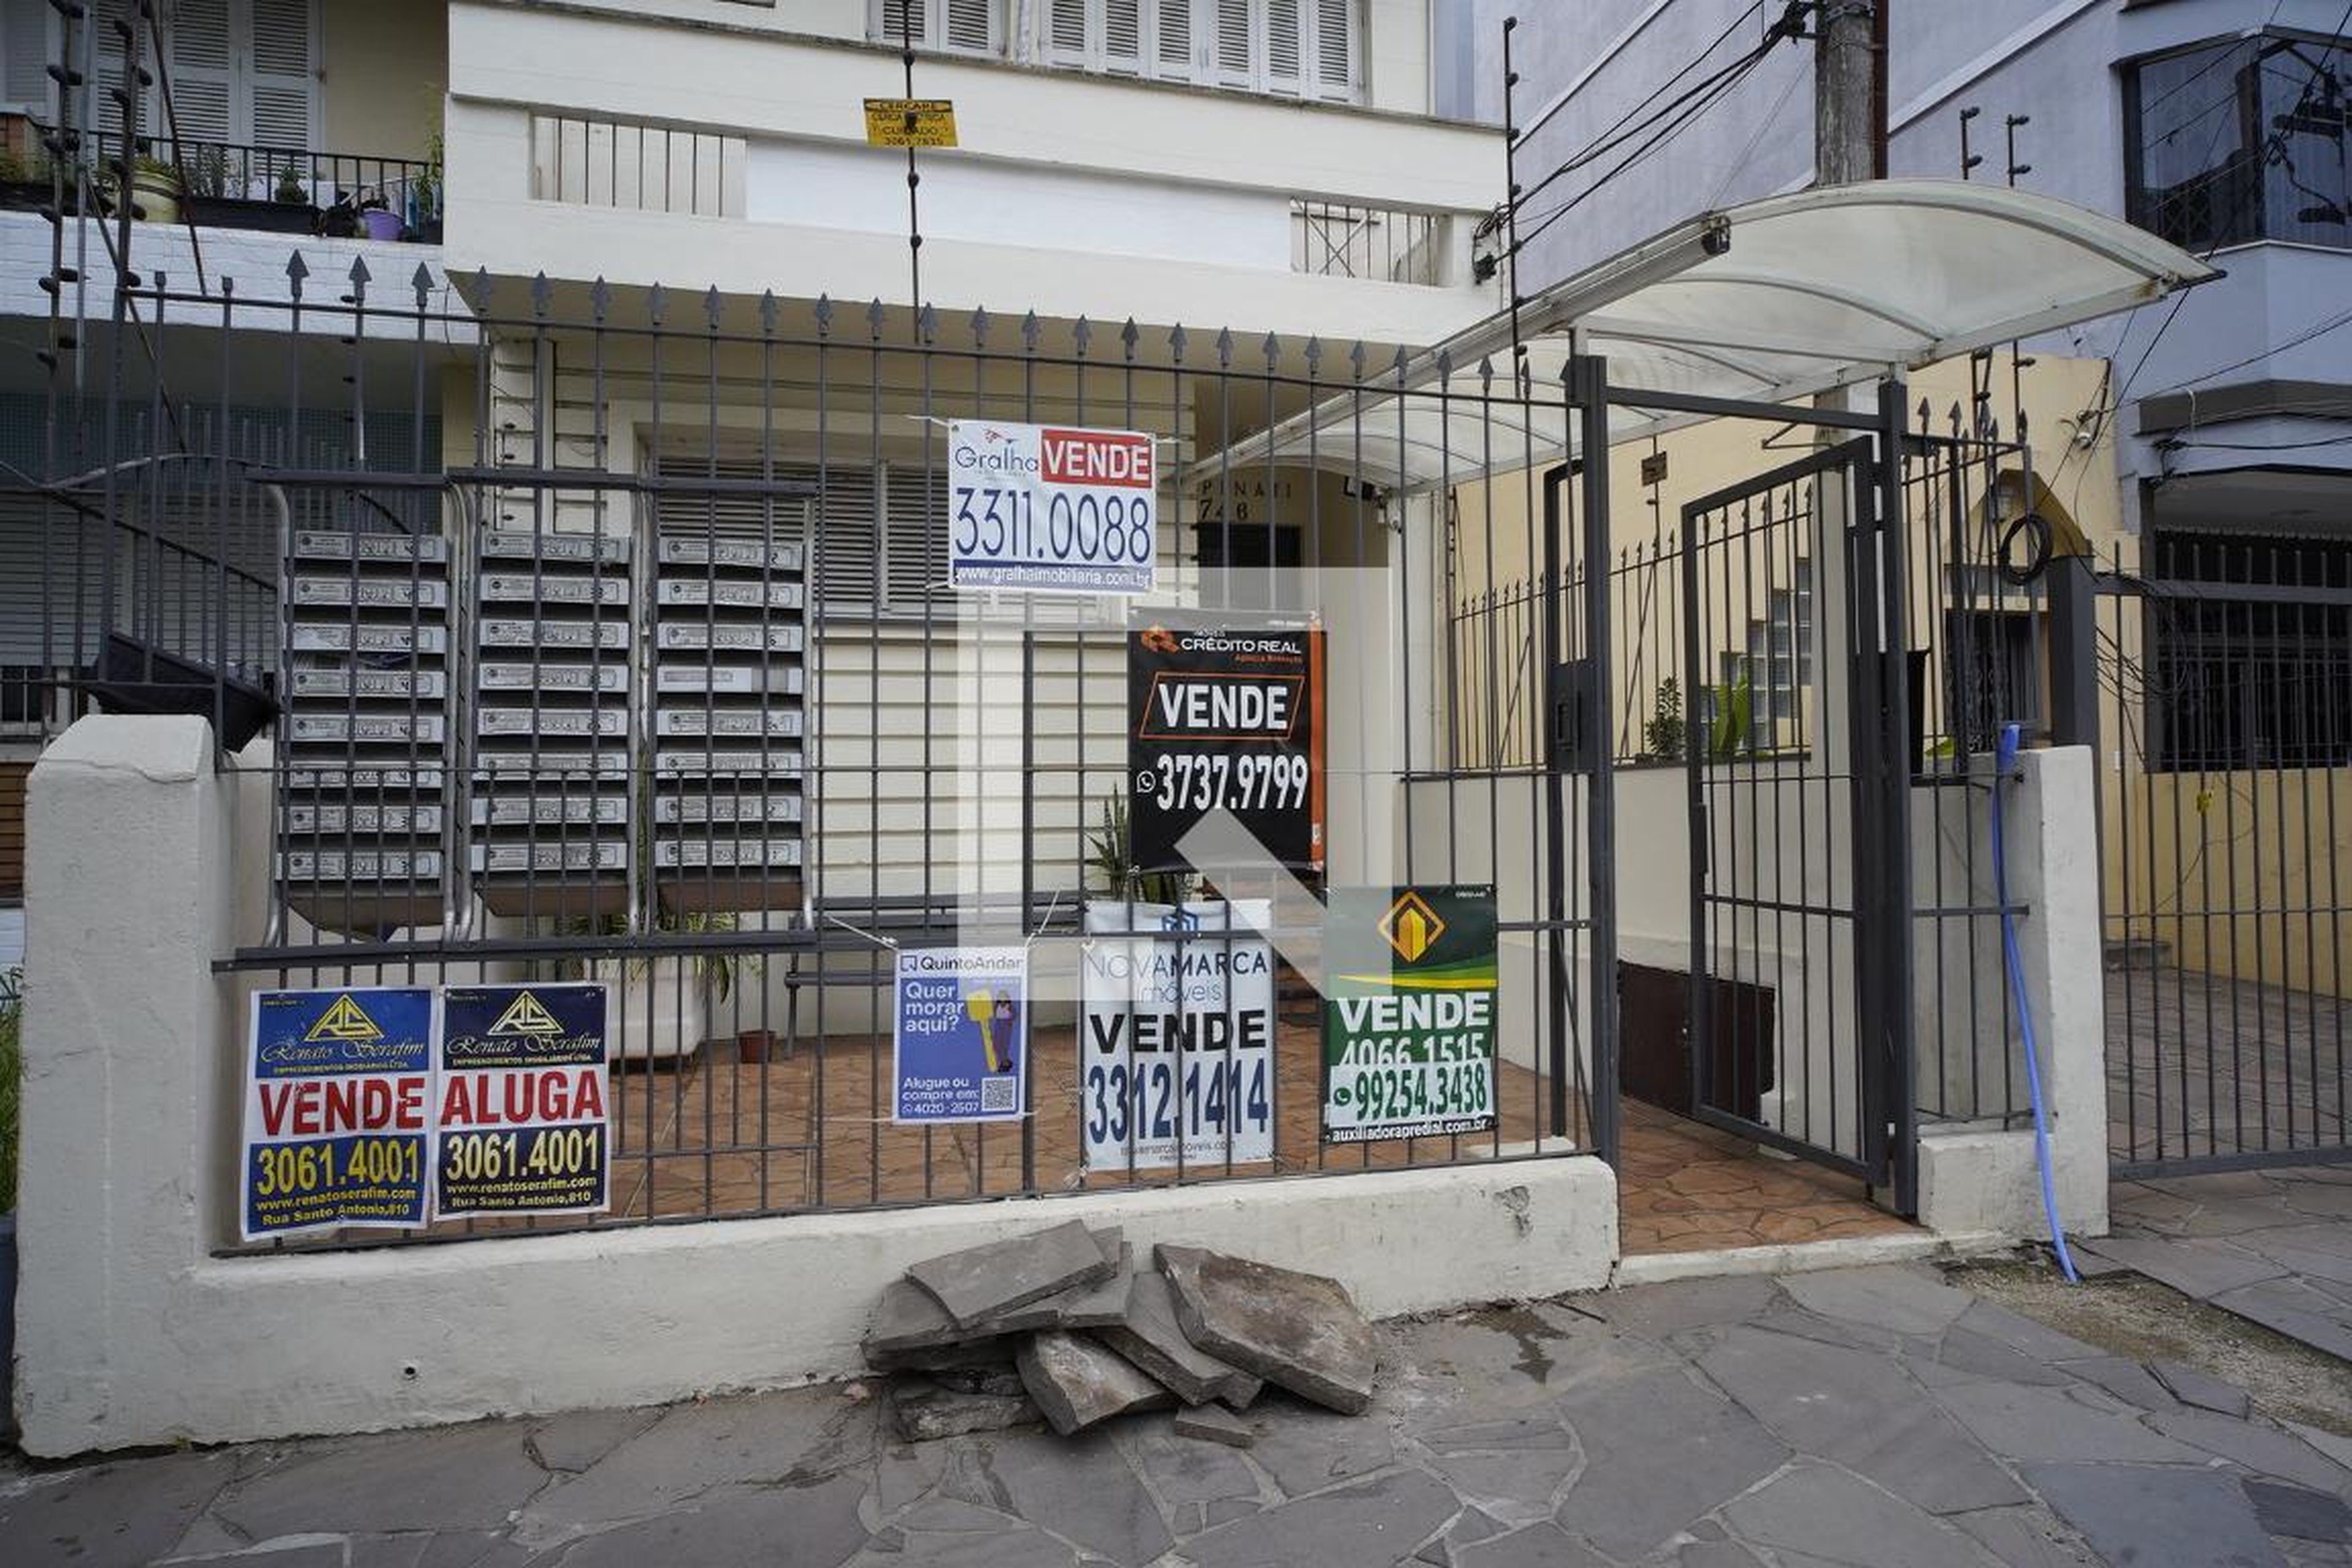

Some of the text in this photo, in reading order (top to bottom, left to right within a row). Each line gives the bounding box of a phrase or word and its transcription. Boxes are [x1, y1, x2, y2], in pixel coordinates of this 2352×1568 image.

[956, 439, 1150, 481] Gralha VENDE
[955, 488, 1150, 563] 3311.0088
[1181, 637, 1302, 654] CRÉDITO REAL
[1158, 684, 1288, 729] VENDE
[1157, 754, 1308, 810] 3737.9799
[921, 956, 1023, 970] QuintoAndar
[907, 982, 956, 1000] Quer
[905, 1002, 965, 1016] morar
[1337, 992, 1490, 1033] VENDE
[905, 1016, 959, 1035] aqui?
[1089, 1010, 1267, 1054] VENDE
[447, 1031, 601, 1055] Renato Serafim
[904, 1077, 969, 1090] Alugue ou
[1355, 1063, 1487, 1121] 99254.3438
[259, 1078, 425, 1136] VENDE
[440, 1070, 603, 1126] ALUGA
[902, 1091, 954, 1103] compre
[1332, 1118, 1487, 1142] auxiliadorapredial.com.br
[447, 1128, 598, 1181] 3061.4001
[257, 1139, 418, 1196] 3061.4001
[447, 1177, 597, 1194] www.renatoserafim.com
[257, 1186, 417, 1212] www.renatoserafim.com
[453, 1197, 477, 1207] Rua
[480, 1196, 515, 1206] Santo
[262, 1215, 289, 1225] Rua
[294, 1208, 334, 1222] Santo
